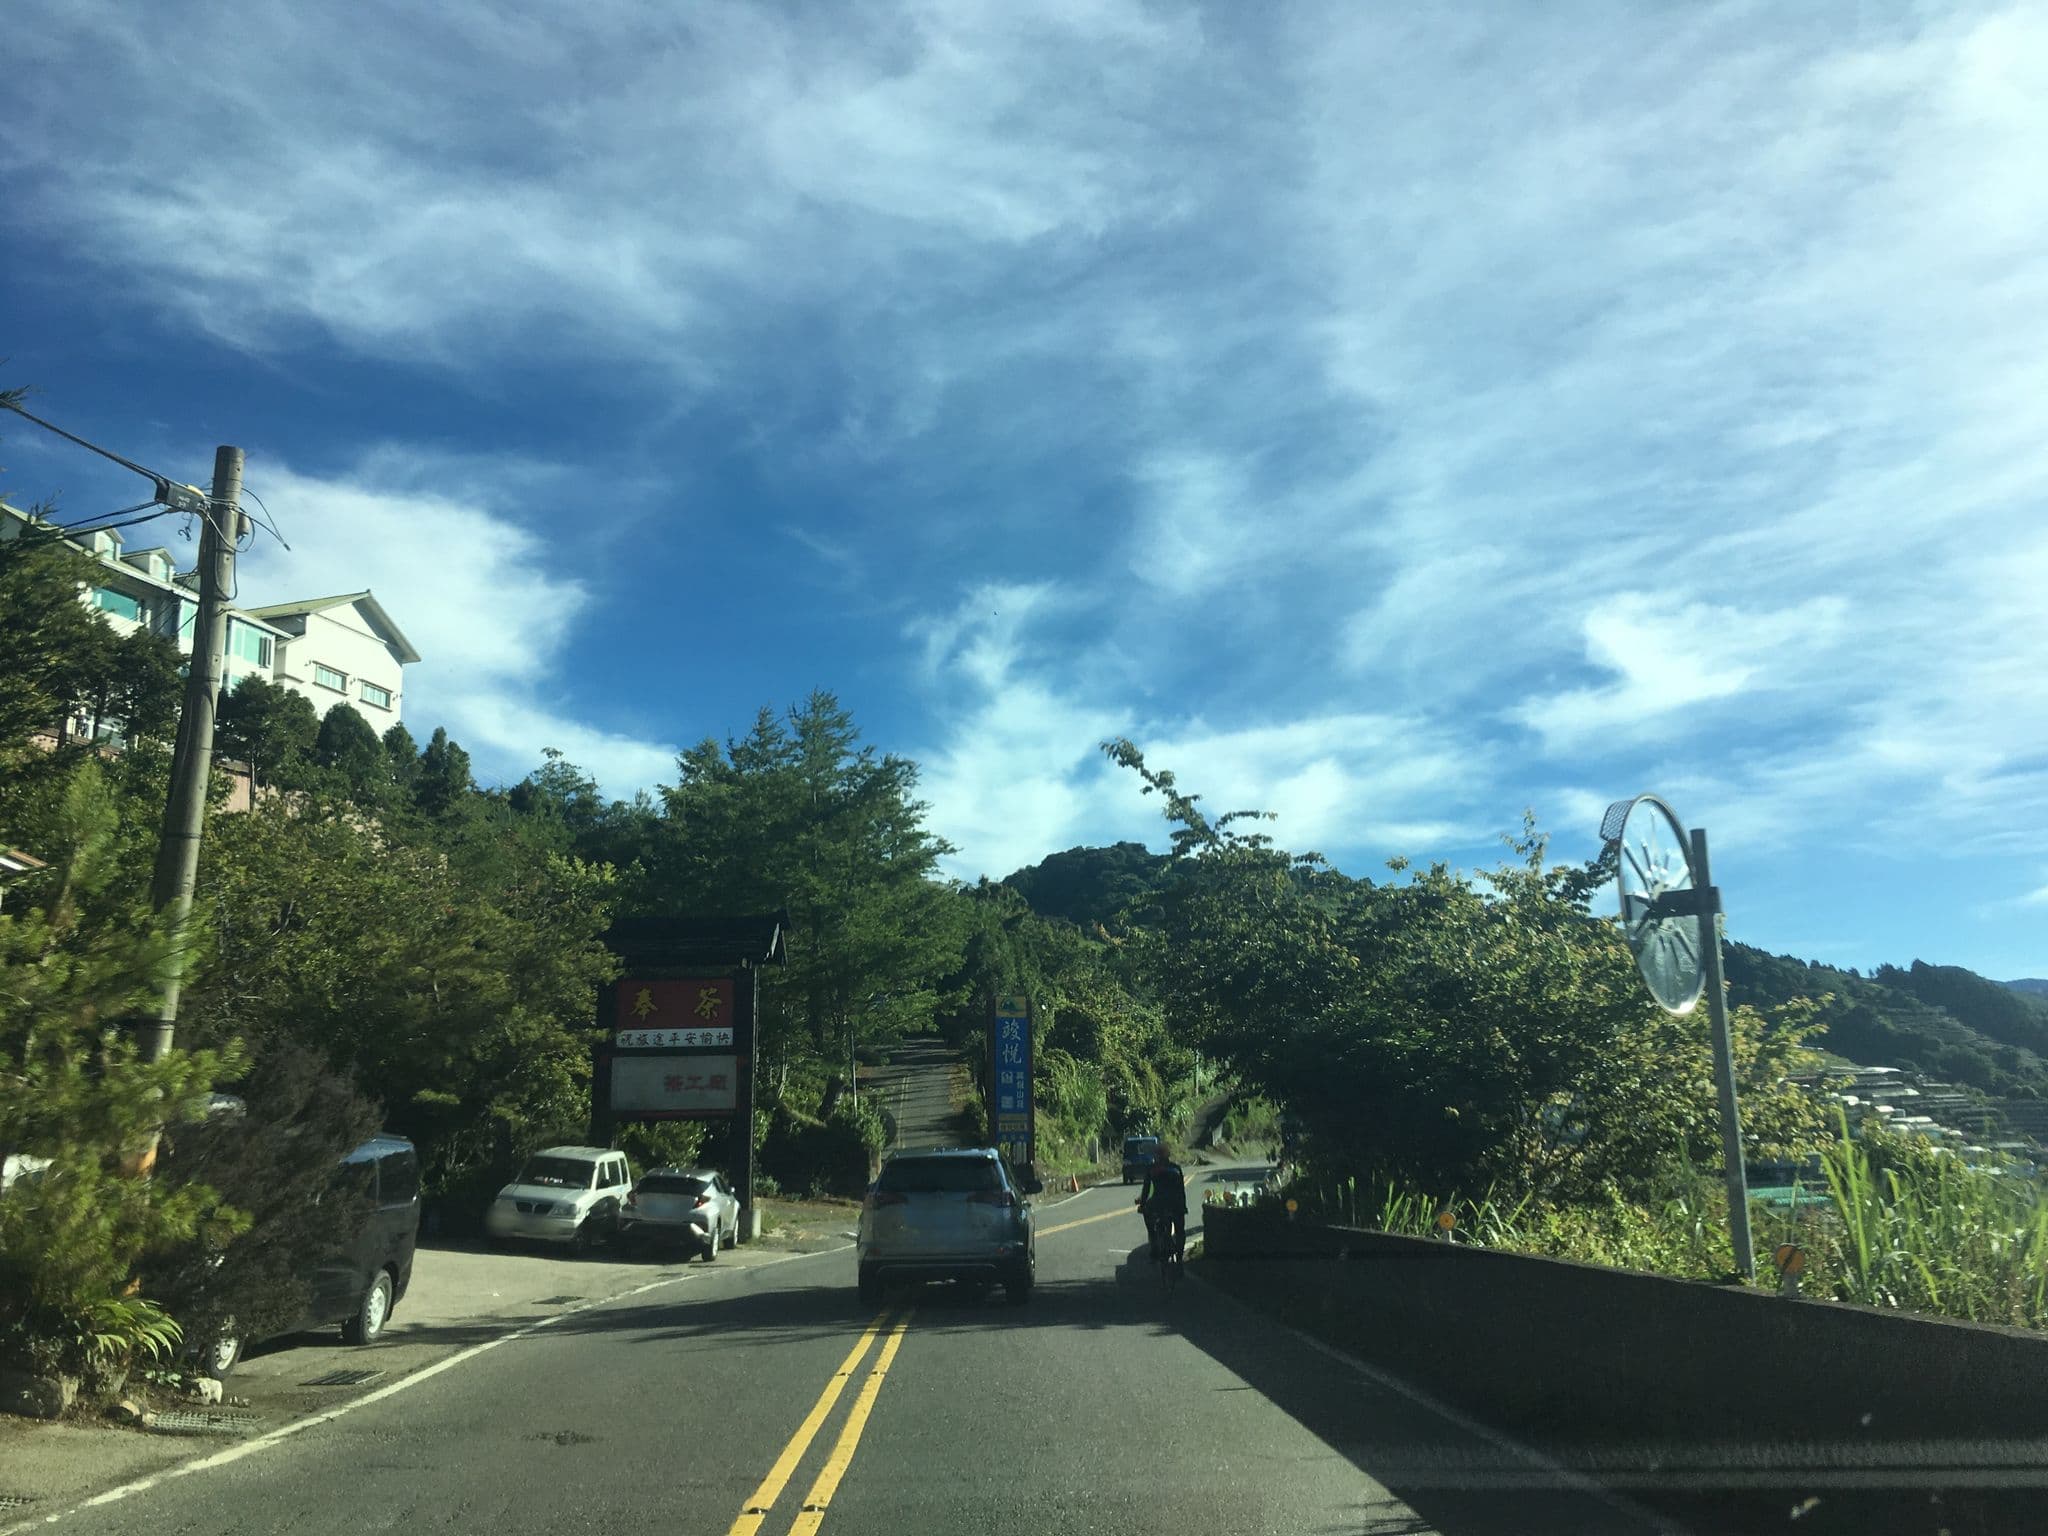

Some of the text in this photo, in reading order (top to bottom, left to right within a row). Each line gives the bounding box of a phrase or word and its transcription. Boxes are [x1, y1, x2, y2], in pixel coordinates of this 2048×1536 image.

[630, 987, 722, 1021] 奉茶
[621, 1031, 731, 1047] 祝旅途平安愉快
